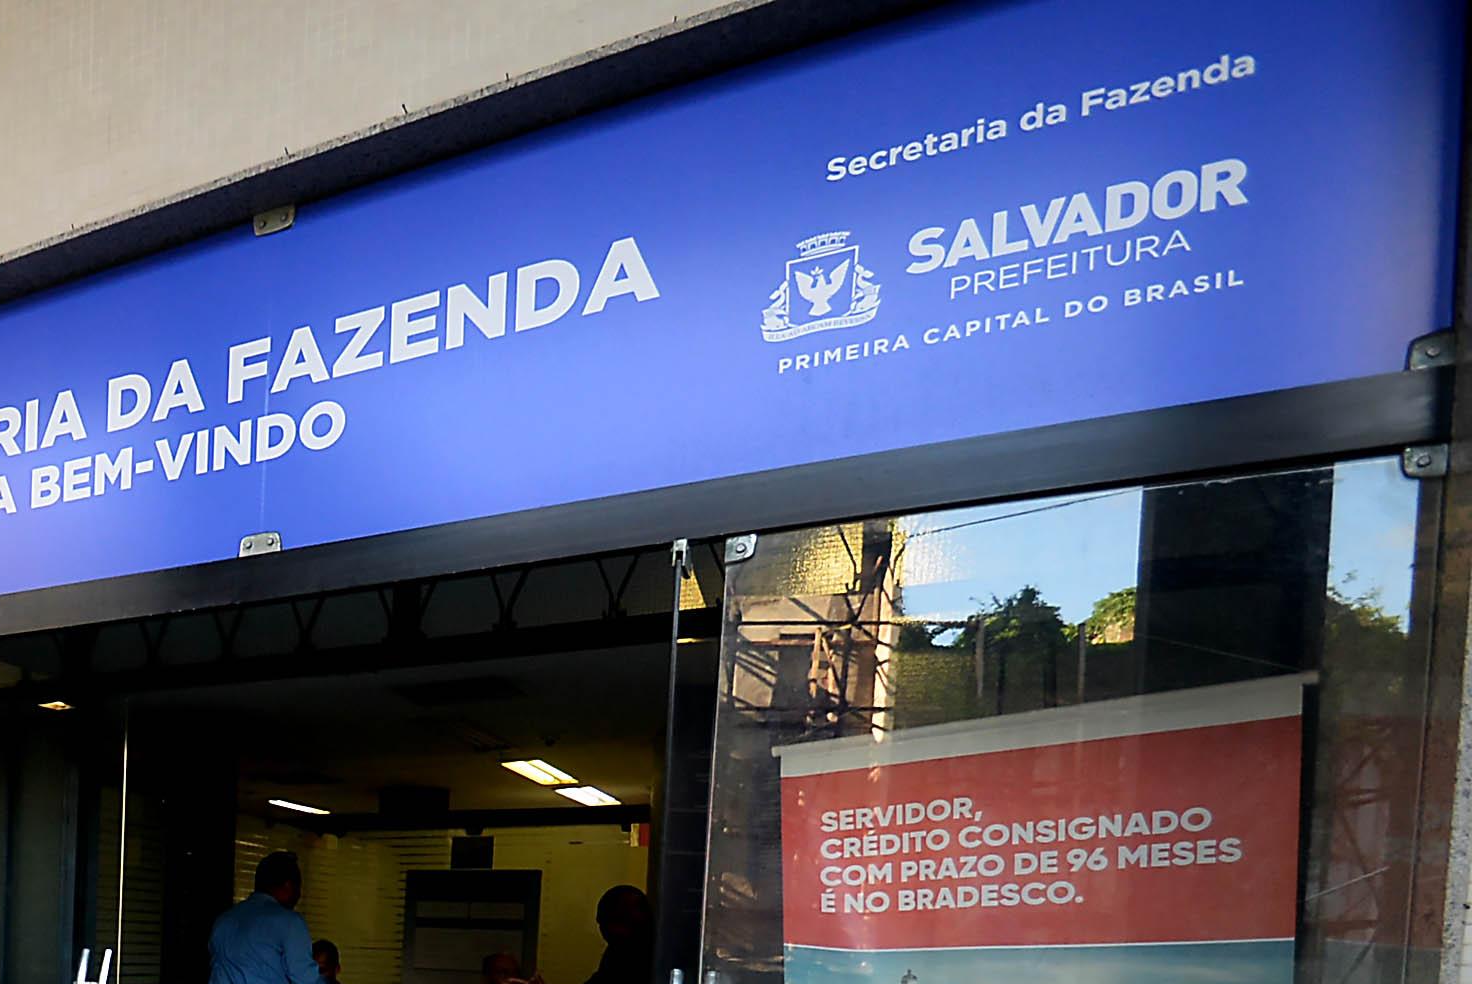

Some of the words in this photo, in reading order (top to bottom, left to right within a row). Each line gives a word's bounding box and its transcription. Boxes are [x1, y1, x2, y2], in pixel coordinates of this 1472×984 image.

[826, 117, 1007, 181] Secretaria
[1020, 102, 1067, 132] da
[1081, 53, 1256, 117] Fazenda
[906, 159, 1248, 275] SALVADOR
[950, 230, 1191, 299] PREFEITURA
[106, 359, 204, 434] DA
[227, 237, 661, 403] FAZENDA
[778, 335, 910, 374] PRIMEIRA
[923, 309, 1049, 345] CAPITAL
[1064, 296, 1108, 319] DO
[1124, 269, 1244, 306] BRASIL
[30, 401, 346, 509] BEM-VINDO
[820, 826, 950, 859] CRÉDITO
[958, 807, 1212, 849] CONSIGNADO
[821, 797, 982, 832] SERVIDOR,
[820, 861, 892, 887] COM
[901, 853, 1005, 882] PRAZO
[1014, 851, 1058, 875] DE
[1067, 847, 1108, 871] 96
[1118, 838, 1242, 868] MESES
[821, 887, 836, 913] É
[844, 891, 890, 914] NO
[898, 881, 1083, 911] BRADESCO.
